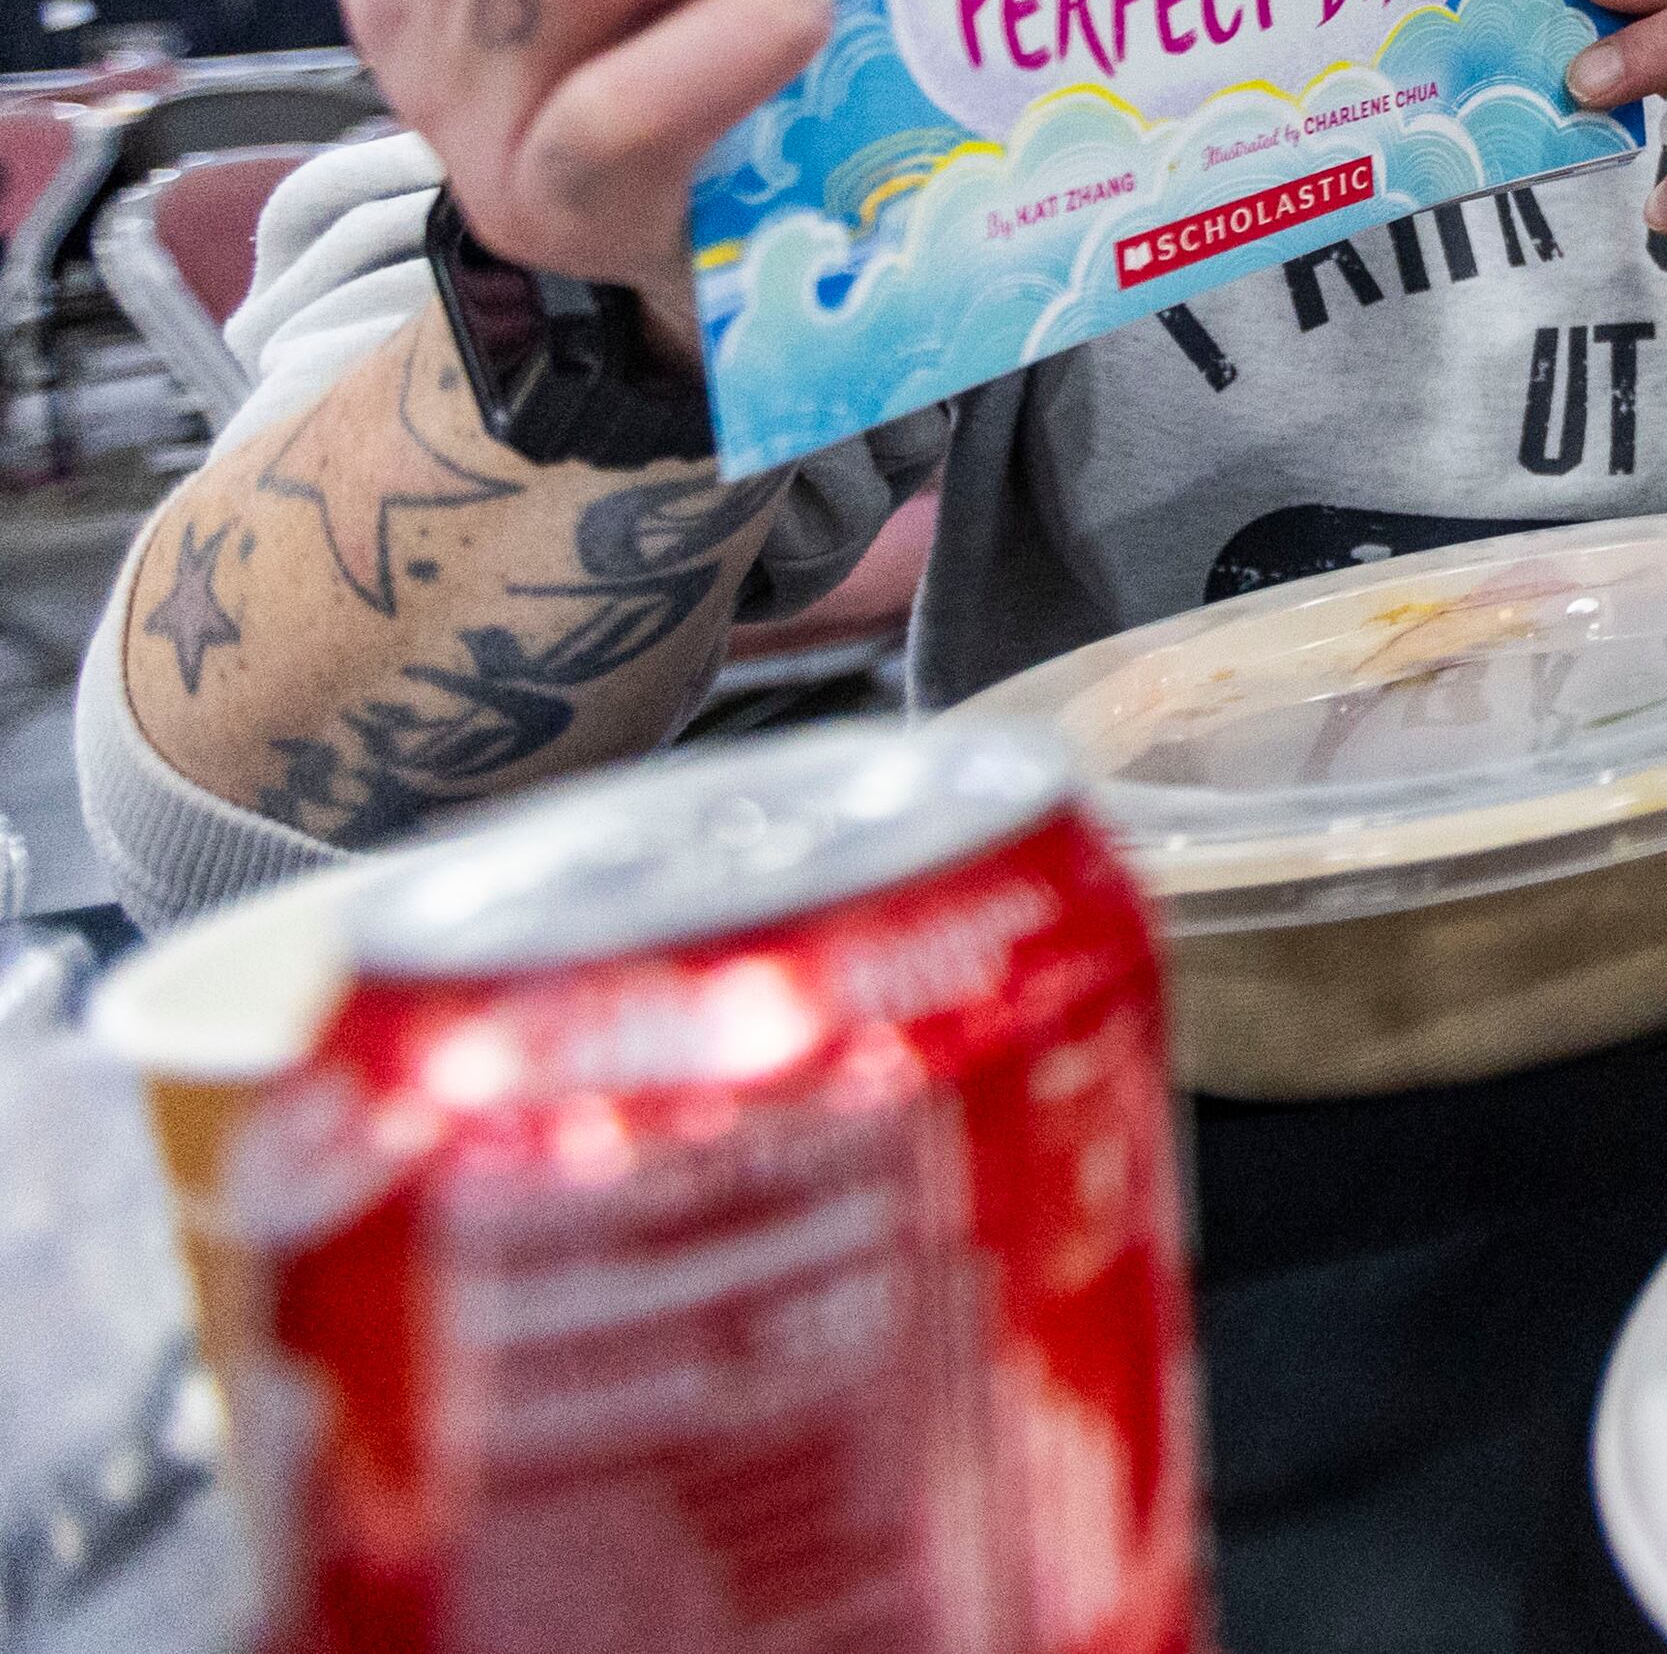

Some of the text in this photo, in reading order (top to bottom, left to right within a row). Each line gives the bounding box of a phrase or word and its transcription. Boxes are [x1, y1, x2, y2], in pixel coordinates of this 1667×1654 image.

[1065, 171, 1136, 212] ZHANG
[1202, 127, 1280, 171] Illustrated
[1284, 124, 1301, 147] by
[1304, 95, 1391, 135] CHARLENE
[1395, 82, 1439, 108] CHUA
[1156, 164, 1369, 261] SCHOLASTIC
[1519, 321, 1656, 476] UT
